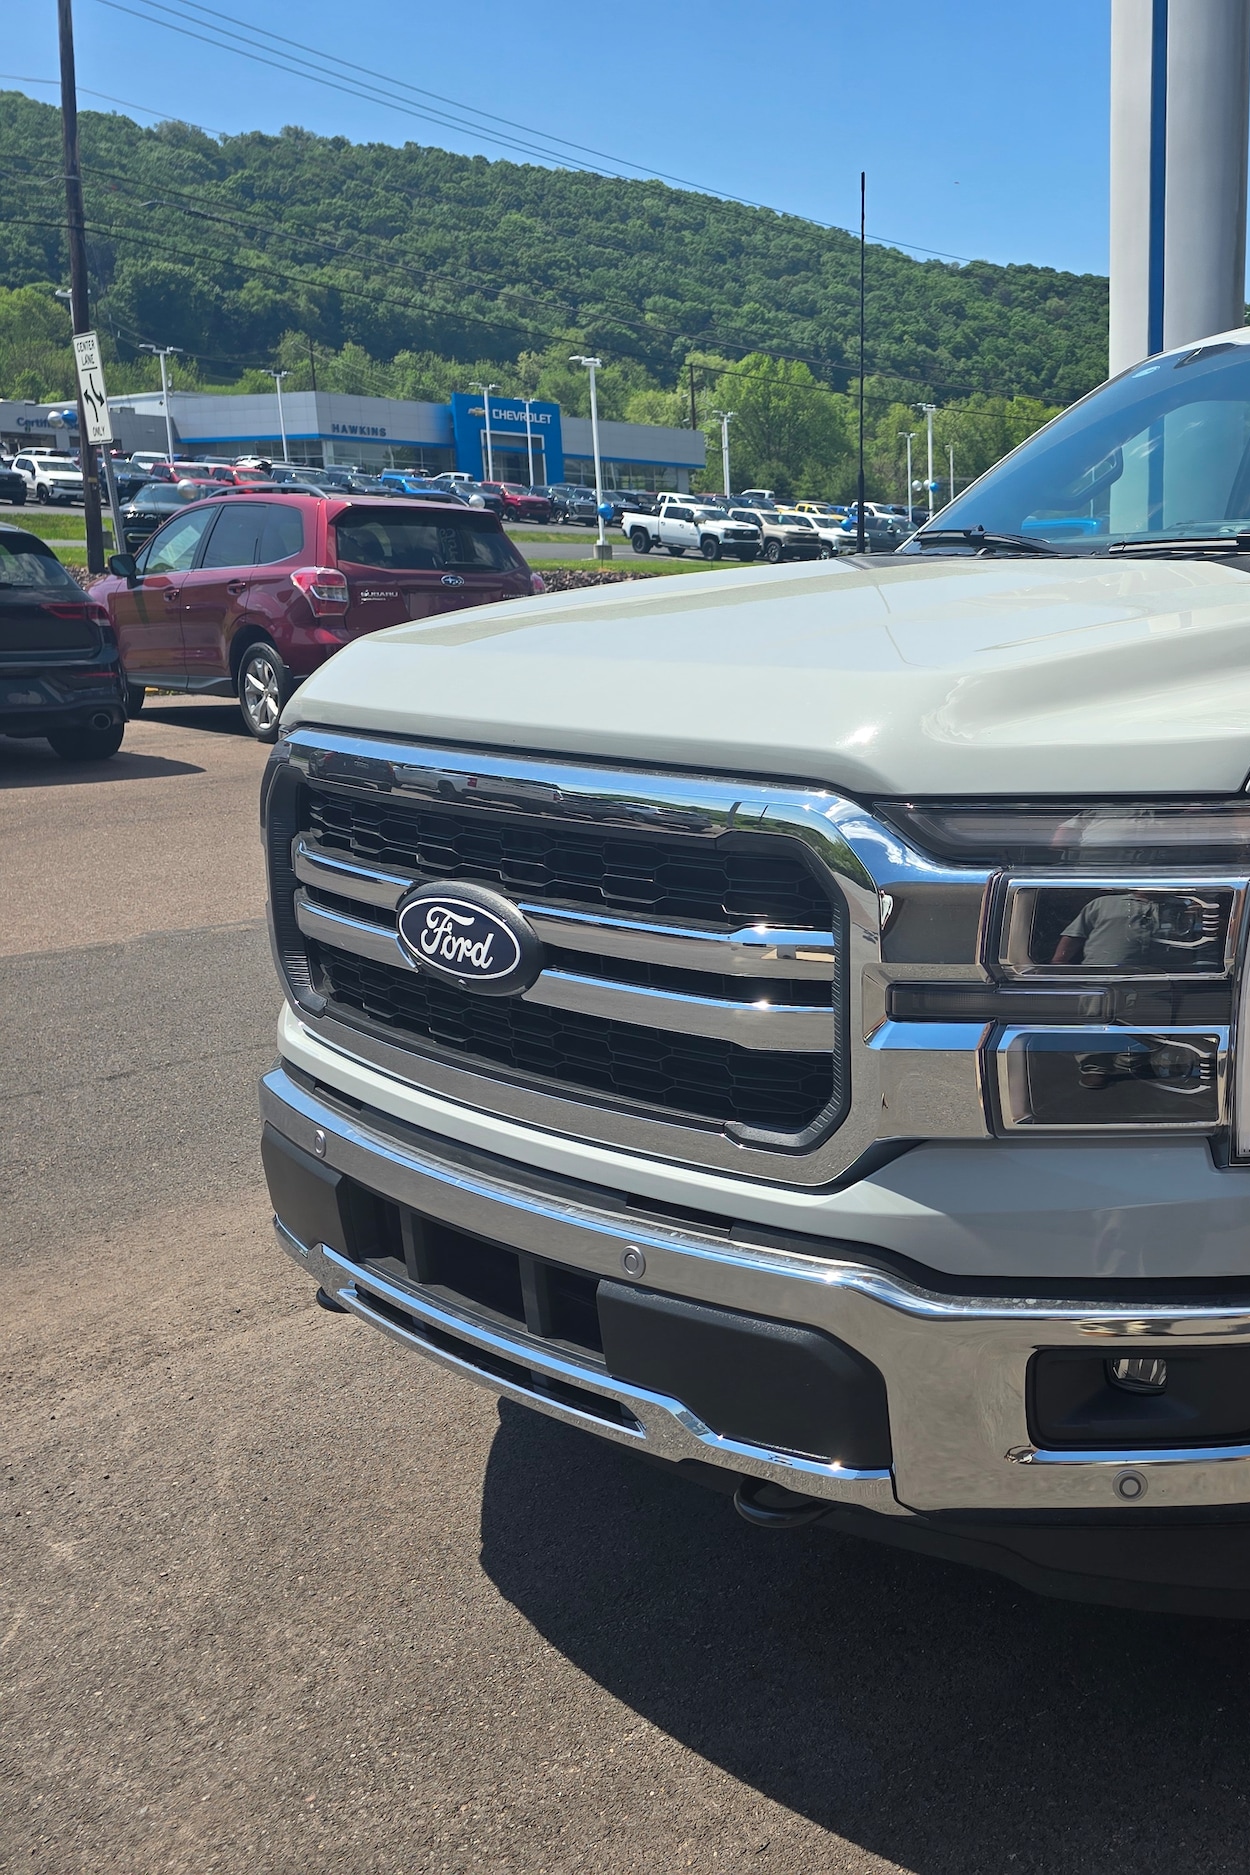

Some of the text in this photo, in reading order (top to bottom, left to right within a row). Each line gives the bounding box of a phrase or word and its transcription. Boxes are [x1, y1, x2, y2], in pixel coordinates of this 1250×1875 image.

[76, 340, 95, 352] CENTER
[81, 353, 95, 366] LANE
[492, 408, 552, 425] CHEVROLET
[92, 426, 106, 437] ONLY
[331, 423, 387, 437] HAWKINS
[420, 906, 495, 969] Ford
